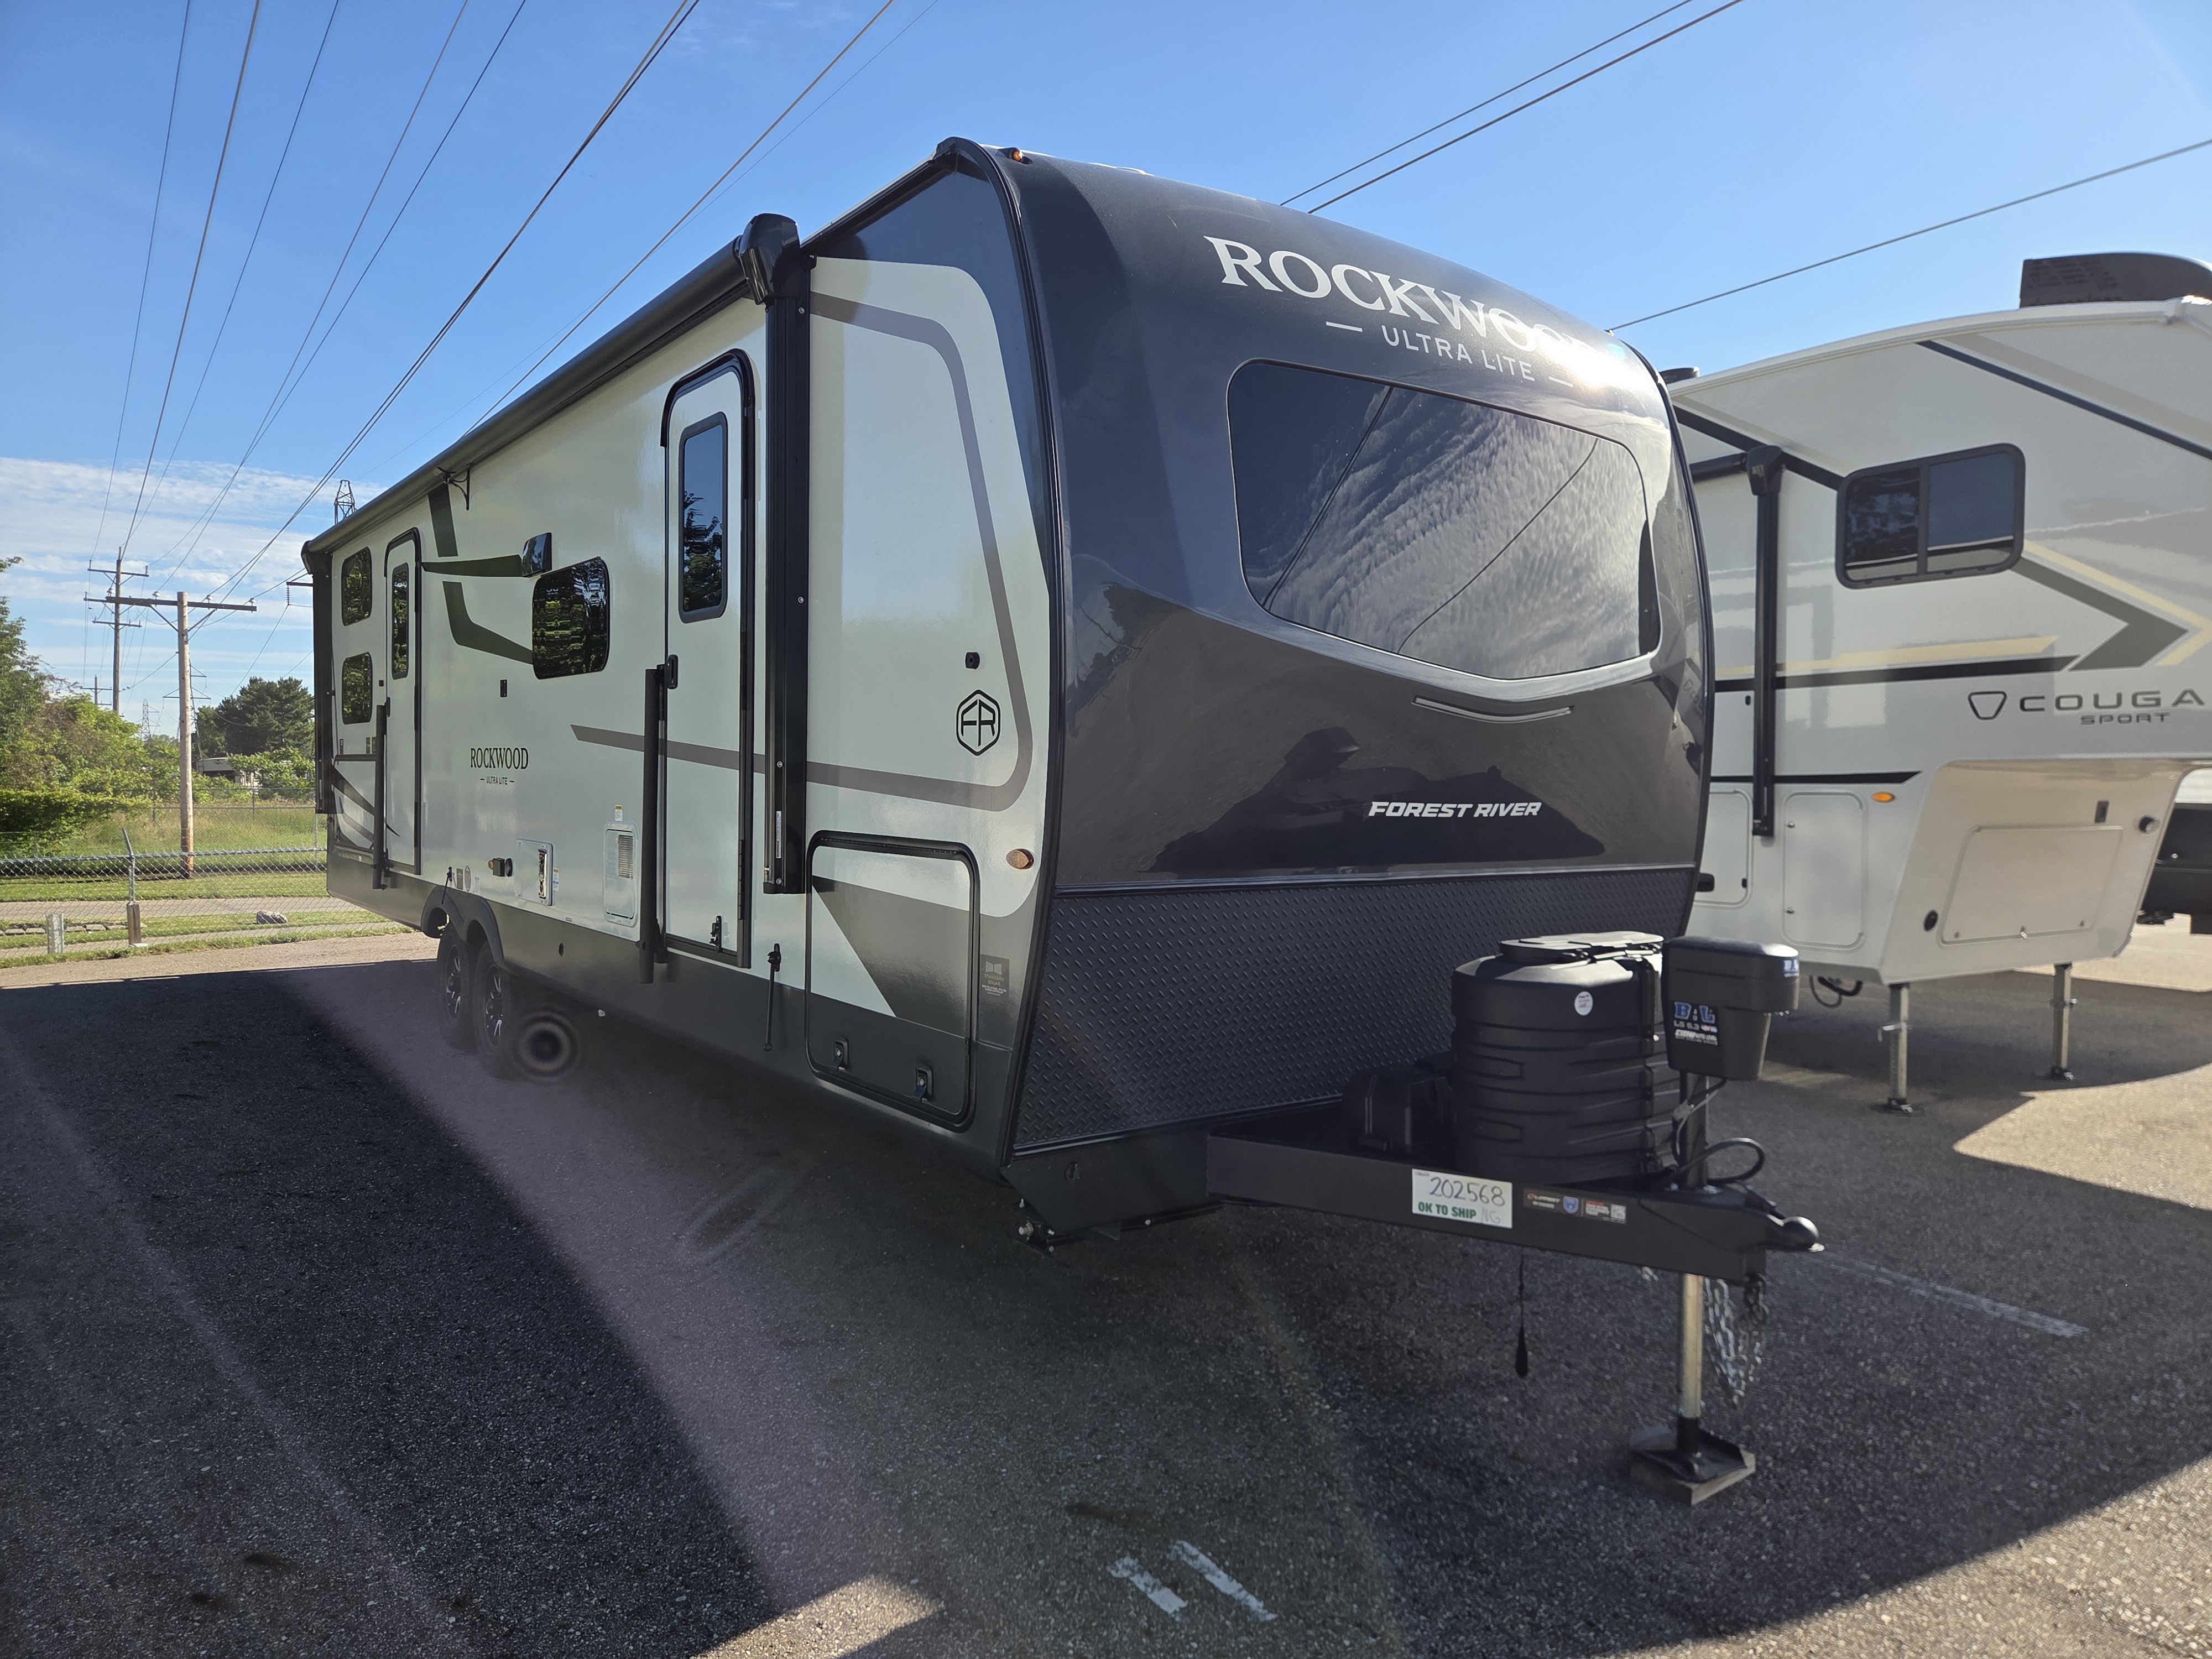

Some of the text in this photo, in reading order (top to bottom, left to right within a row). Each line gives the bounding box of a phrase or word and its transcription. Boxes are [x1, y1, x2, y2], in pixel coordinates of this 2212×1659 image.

[1203, 236, 1598, 353] ROCKWO
[1382, 325, 1536, 382] ULTRA LITE
[2019, 688, 2205, 712] COUGA
[2080, 712, 2171, 725] SPORT
[470, 747, 529, 769] ROCKWOOD
[487, 776, 498, 784] ULTRA
[1368, 801, 1542, 817] FOREST RIVER
[1430, 1176, 1506, 1207] 202568
[1418, 1201, 1477, 1219] OK TO SHIP
